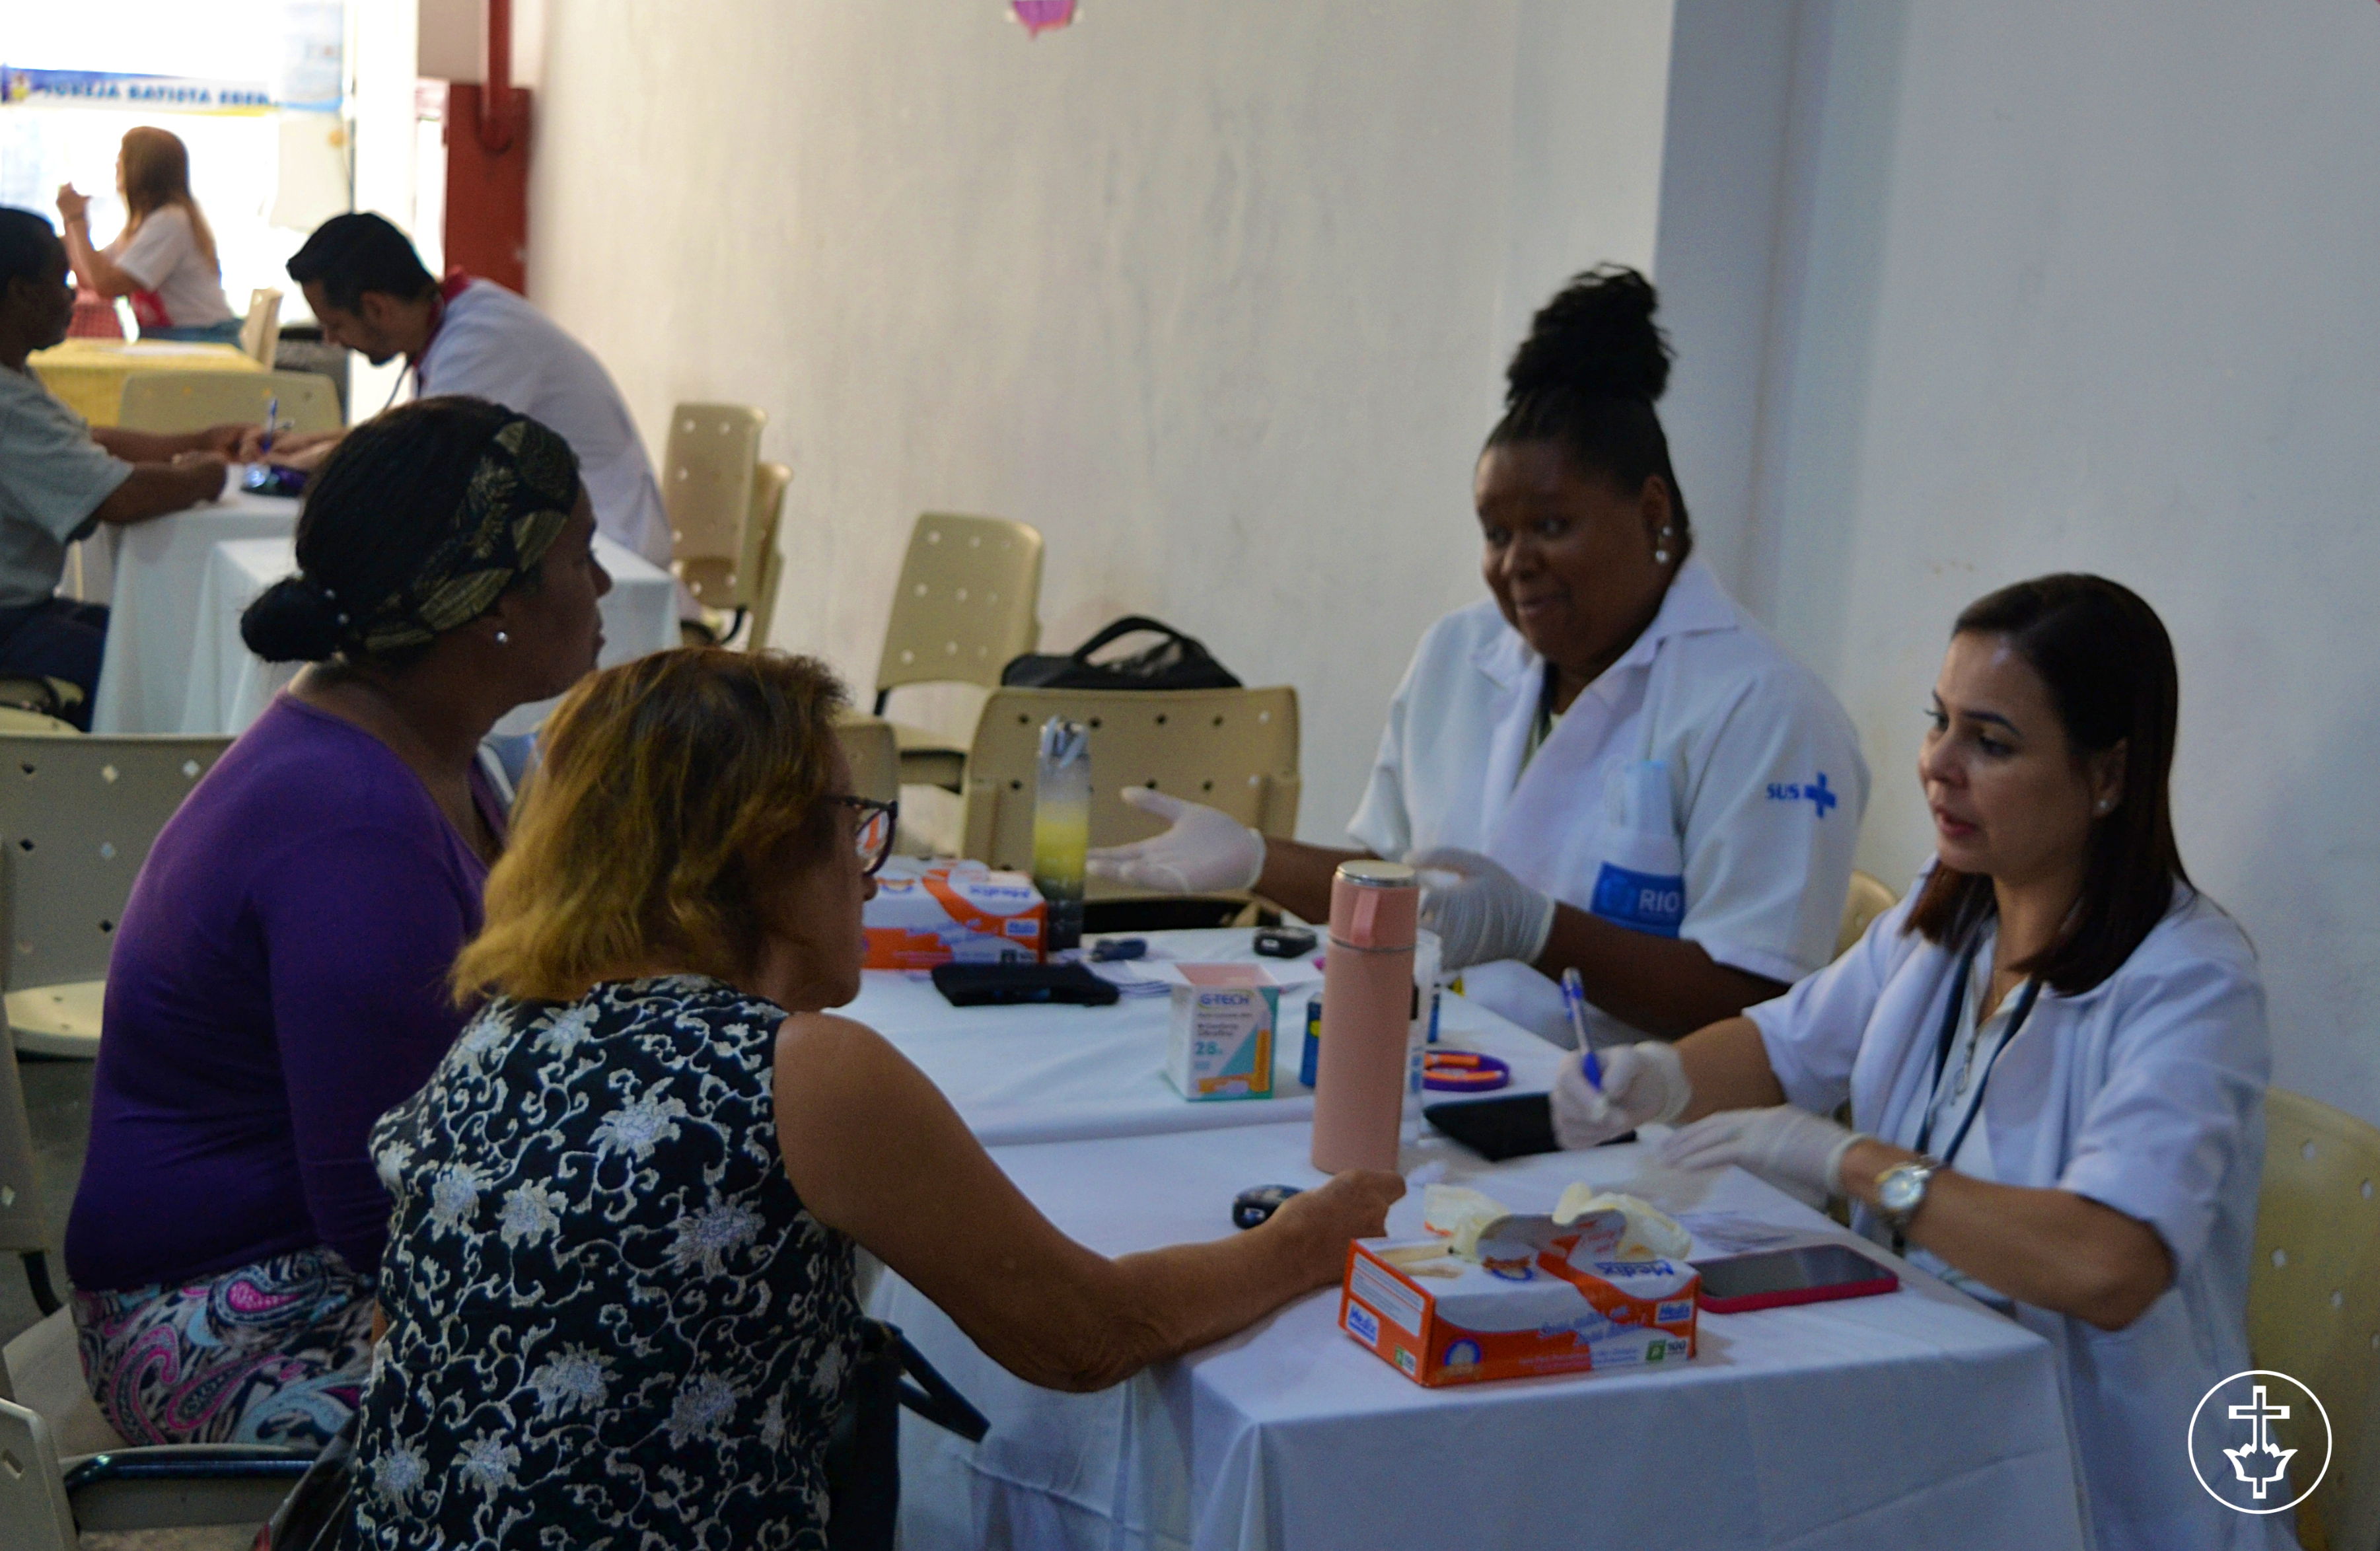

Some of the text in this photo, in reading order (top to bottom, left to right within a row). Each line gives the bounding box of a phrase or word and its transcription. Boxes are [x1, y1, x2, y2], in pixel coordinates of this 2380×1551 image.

[128, 85, 211, 104] BATISTA
[1766, 782, 1800, 801] SUS
[1638, 887, 1680, 913] RIO
